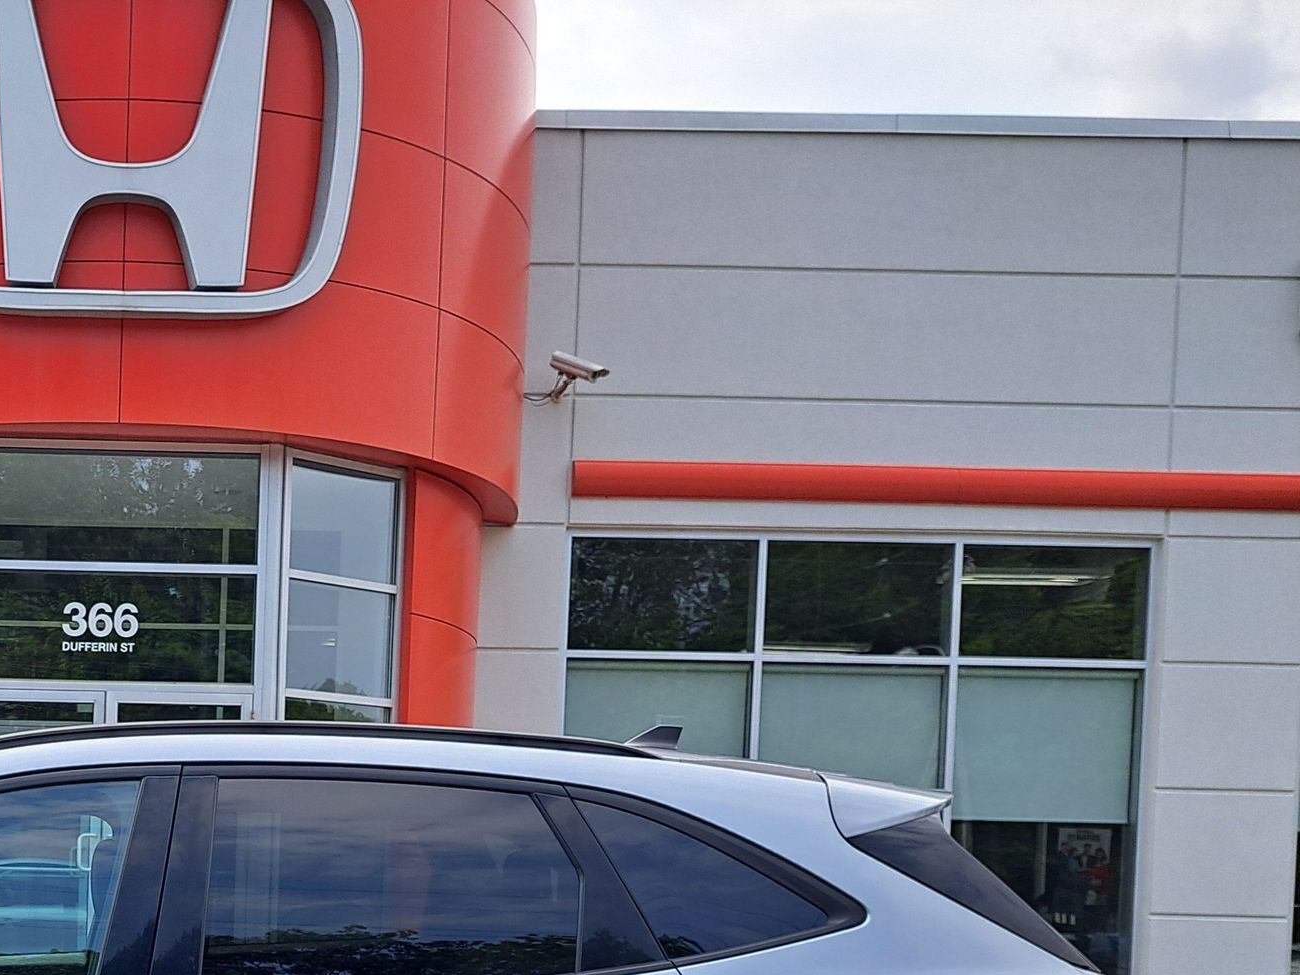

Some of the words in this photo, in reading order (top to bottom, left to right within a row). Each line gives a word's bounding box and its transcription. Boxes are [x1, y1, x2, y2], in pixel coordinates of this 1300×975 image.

[62, 602, 139, 638] 366
[61, 642, 118, 653] DUFFERIN
[120, 643, 136, 653] ST
